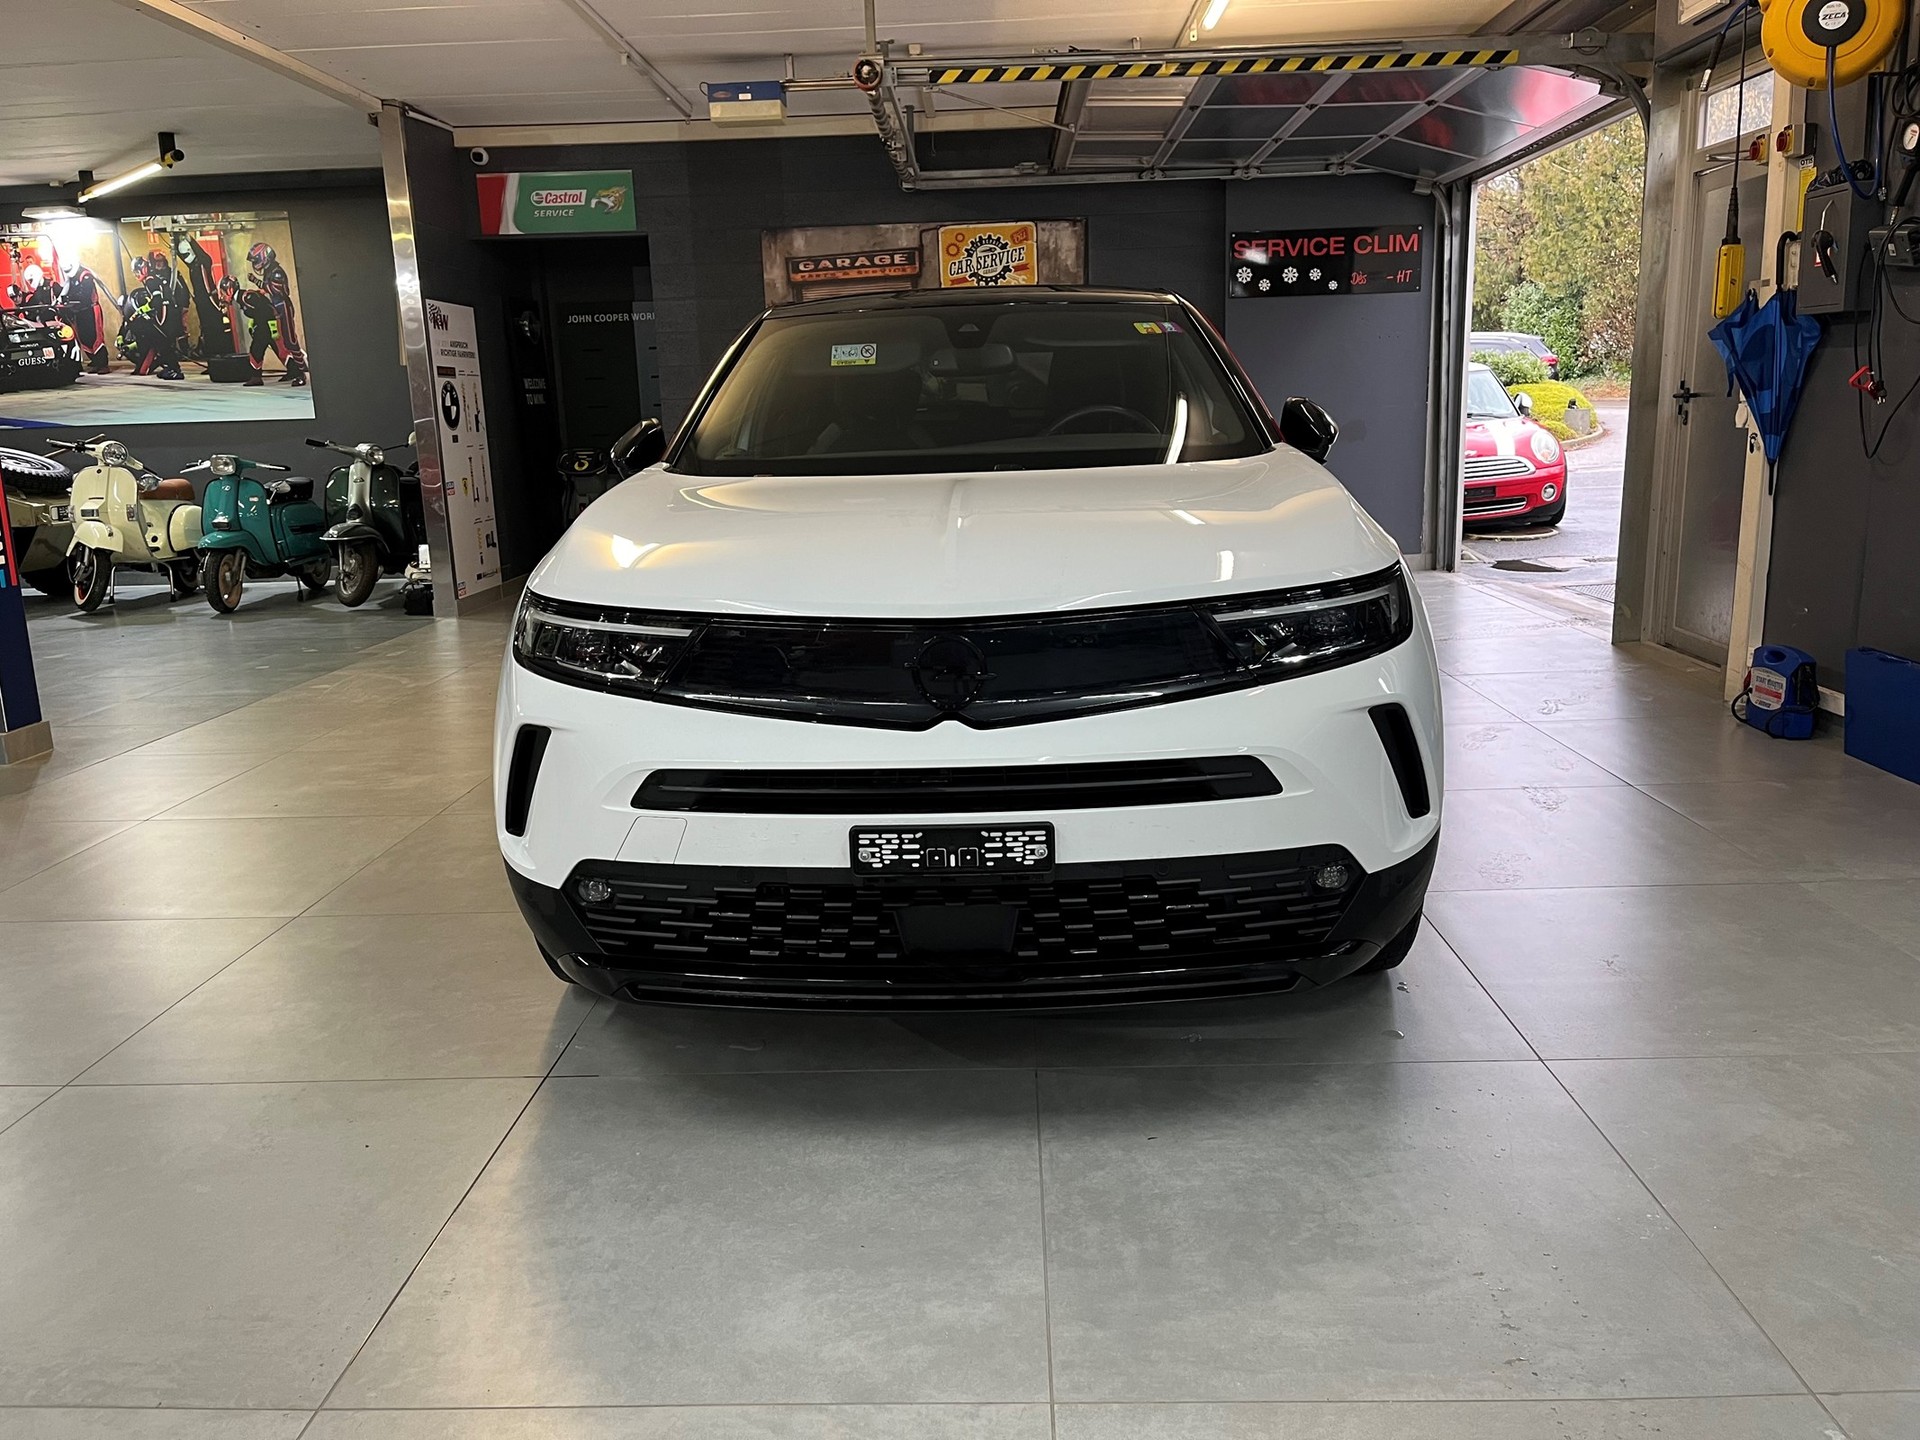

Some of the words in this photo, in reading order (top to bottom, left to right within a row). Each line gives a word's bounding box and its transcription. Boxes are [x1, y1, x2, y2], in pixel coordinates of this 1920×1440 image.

[1821, 11, 1846, 21] ZECA
[544, 191, 583, 205] Castrol
[534, 209, 575, 217] SERVICE
[1233, 236, 1345, 259] SERVICE
[1353, 233, 1419, 255] CLIM
[798, 253, 909, 271] GARAGE
[949, 258, 975, 276] CAR
[976, 246, 1025, 271] SERVICE
[800, 271, 836, 279] PARTS
[857, 266, 909, 276] SERVICE
[1397, 269, 1413, 283] HT
[567, 314, 592, 324] JOHN
[594, 313, 630, 323] COOPER
[18, 357, 46, 367] GUESS
